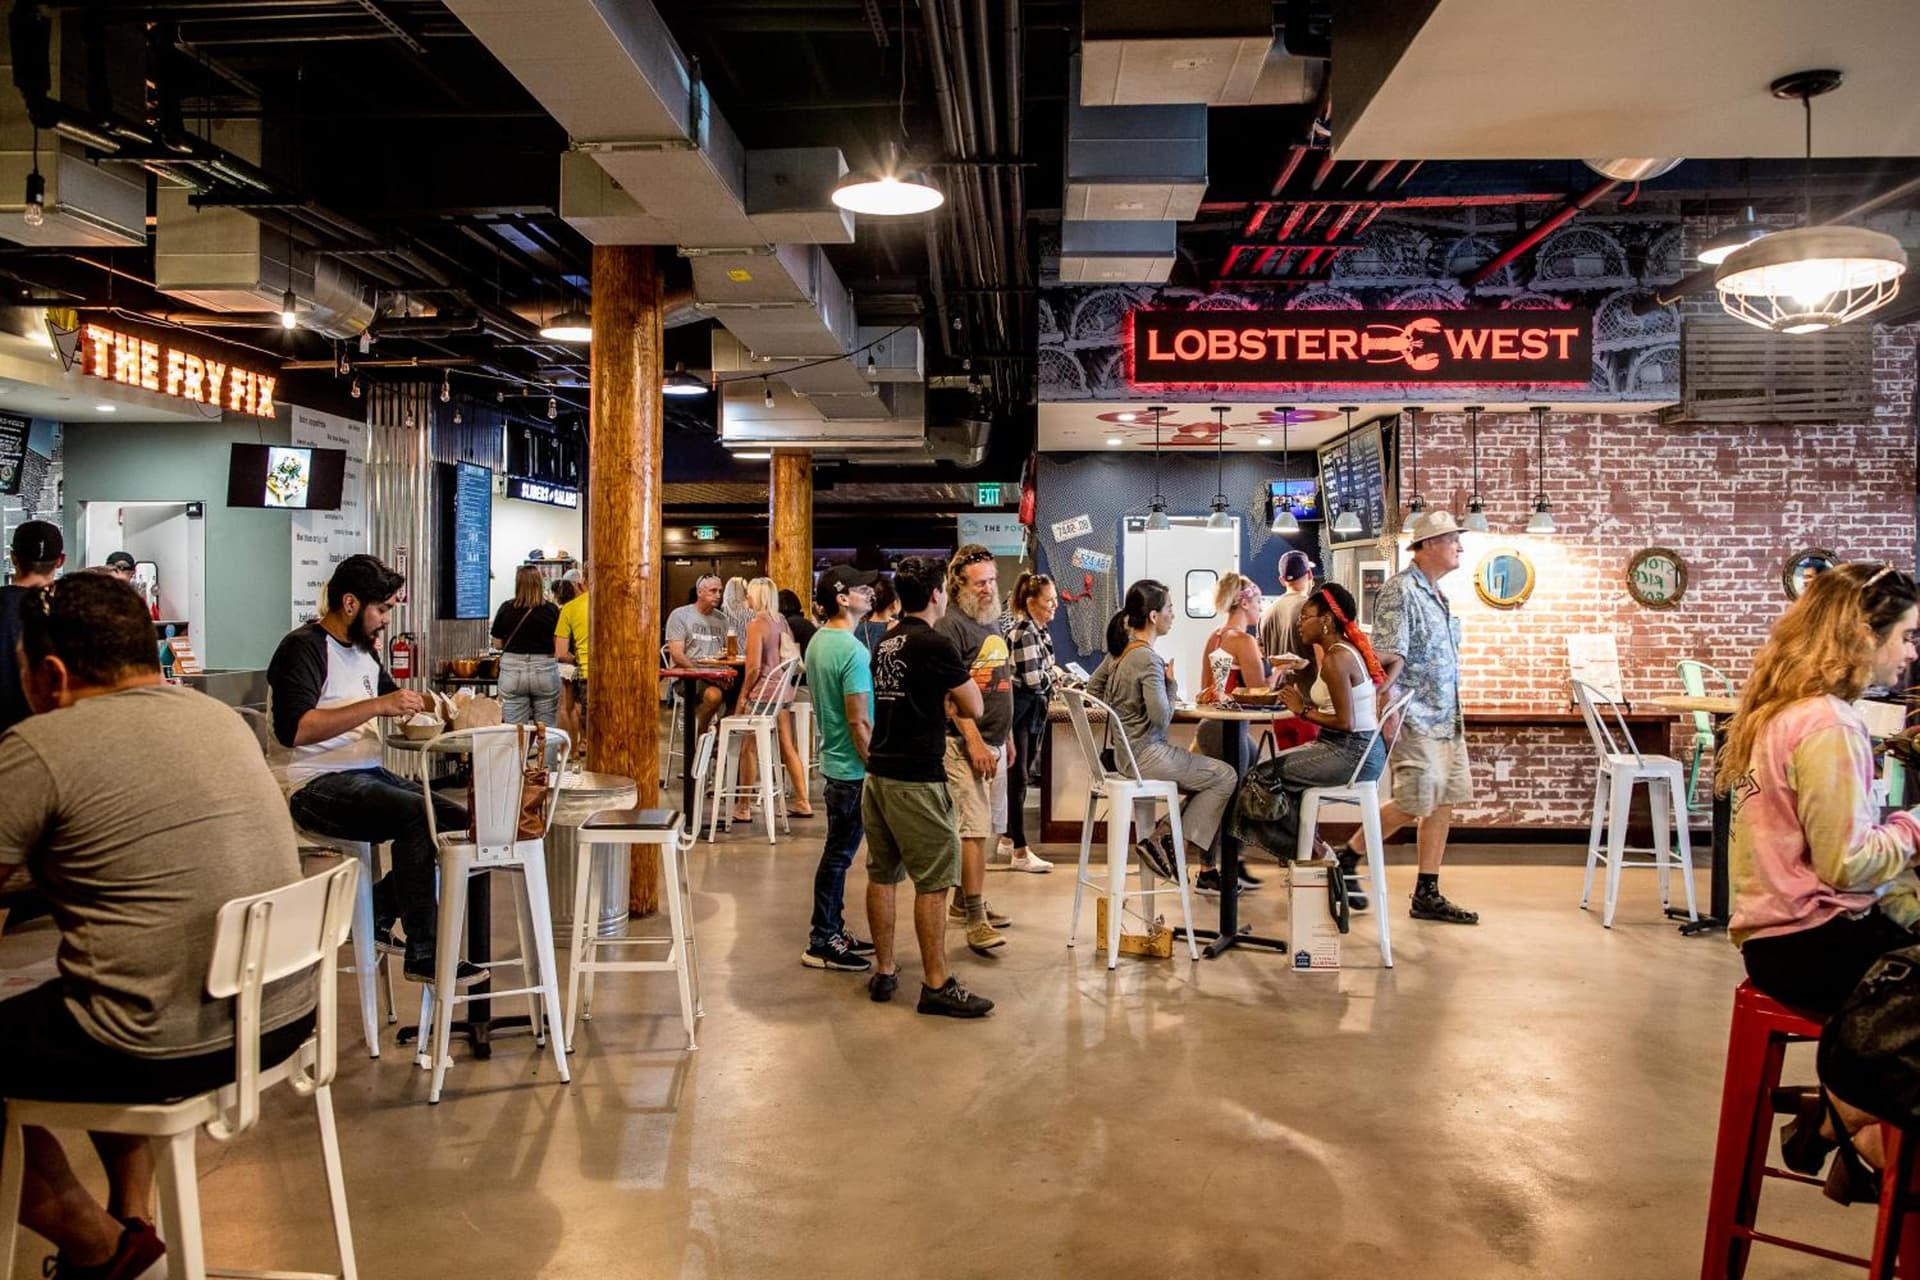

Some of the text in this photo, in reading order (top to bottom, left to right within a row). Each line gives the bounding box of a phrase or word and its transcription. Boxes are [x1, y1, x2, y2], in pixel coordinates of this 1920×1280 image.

[1148, 327, 1579, 361] LOBSTER WEST
[87, 323, 277, 418] THE FRY FIX
[979, 488, 1000, 505] EXIT
[984, 524, 1001, 532] THE
